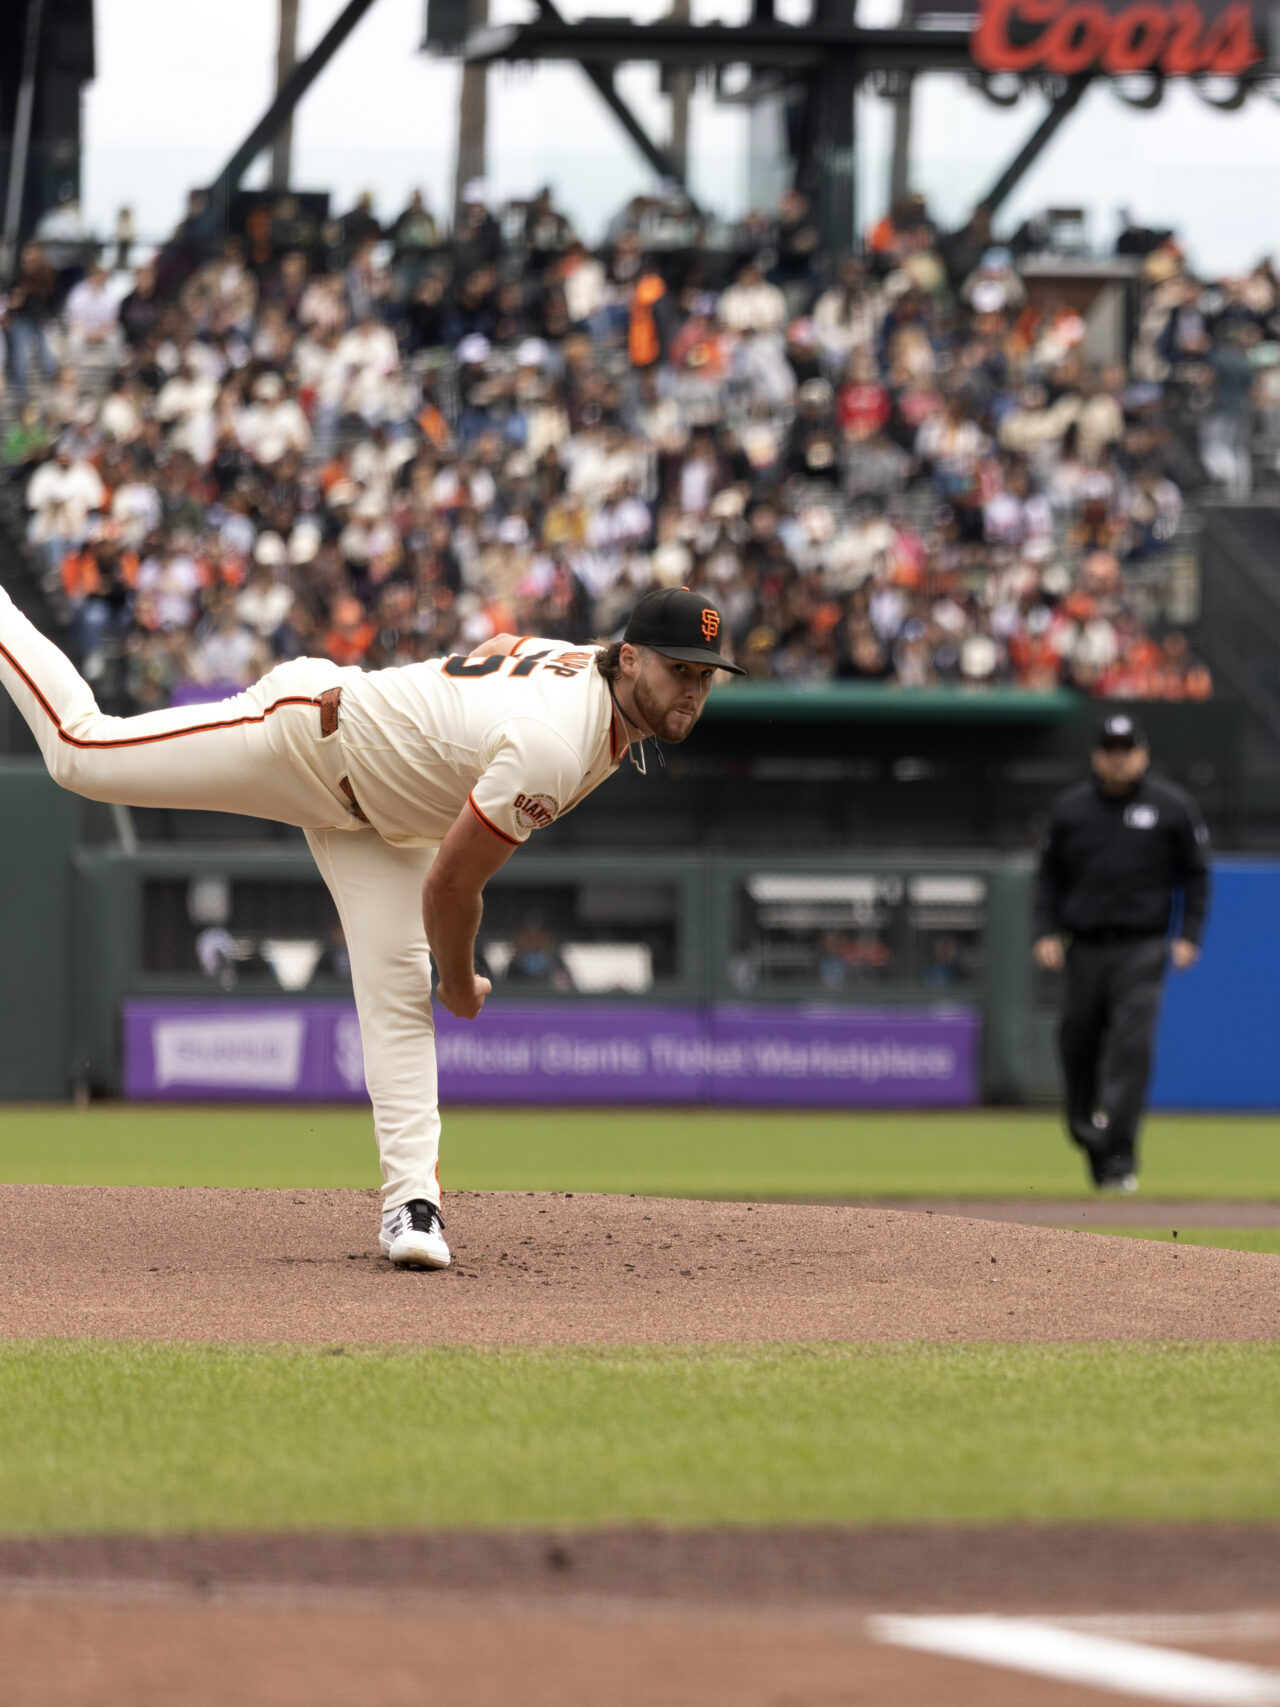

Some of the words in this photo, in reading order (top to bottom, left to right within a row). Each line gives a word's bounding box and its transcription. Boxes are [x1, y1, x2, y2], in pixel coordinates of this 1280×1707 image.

[971, 0, 1264, 76] Coors
[437, 1032, 535, 1075] fficial
[538, 1033, 645, 1077] Giants
[648, 1034, 743, 1078] Ticket
[752, 1036, 955, 1084] Marketplace
